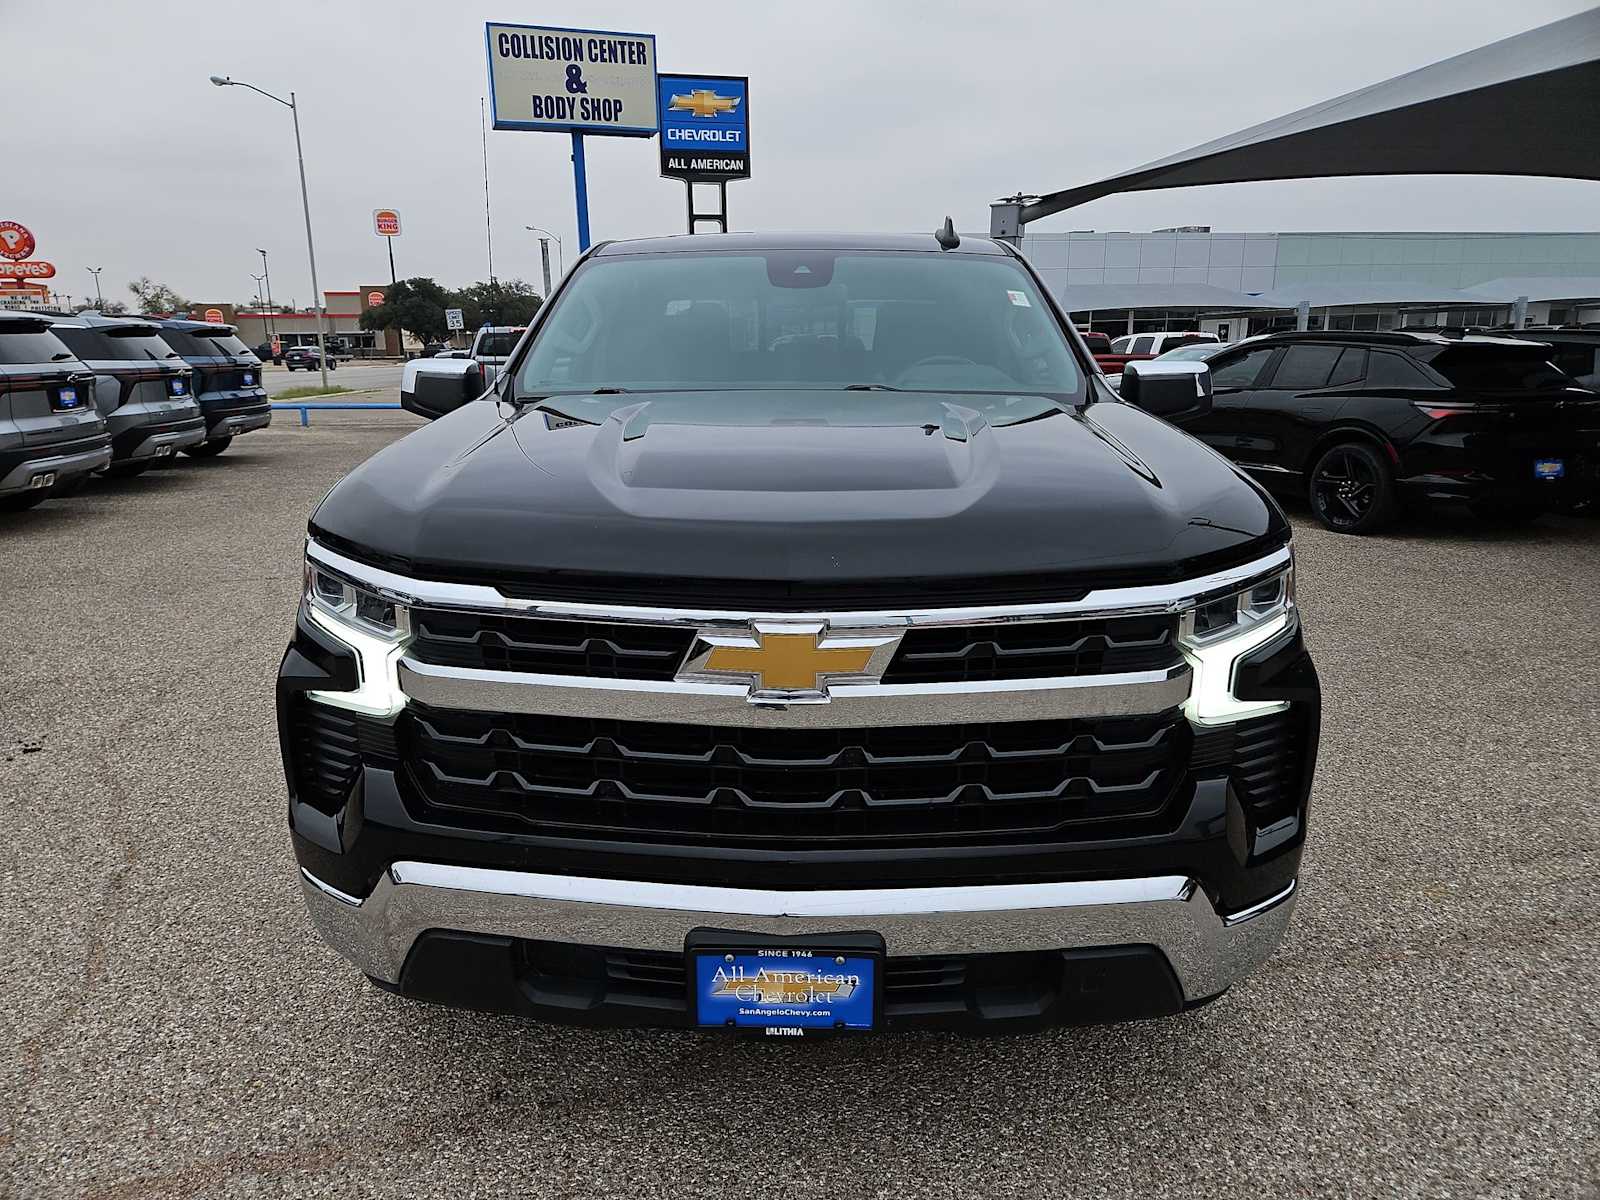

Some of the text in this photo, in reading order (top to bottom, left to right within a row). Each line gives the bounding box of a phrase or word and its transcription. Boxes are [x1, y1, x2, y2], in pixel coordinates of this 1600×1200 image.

[498, 32, 647, 65] COLLISION CENTER
[565, 63, 588, 94] &
[532, 95, 623, 122] BODY SHOP
[667, 128, 742, 142] CHEVROLET
[668, 158, 744, 170] ALL AMERICAN
[449, 319, 462, 328] 35
[758, 950, 813, 958] SINCE 1946
[711, 965, 861, 986] All American
[735, 984, 833, 1004] Chevrolet
[738, 1007, 831, 1017] SanAngeloChevy.com
[774, 1027, 804, 1036] LITHIA
